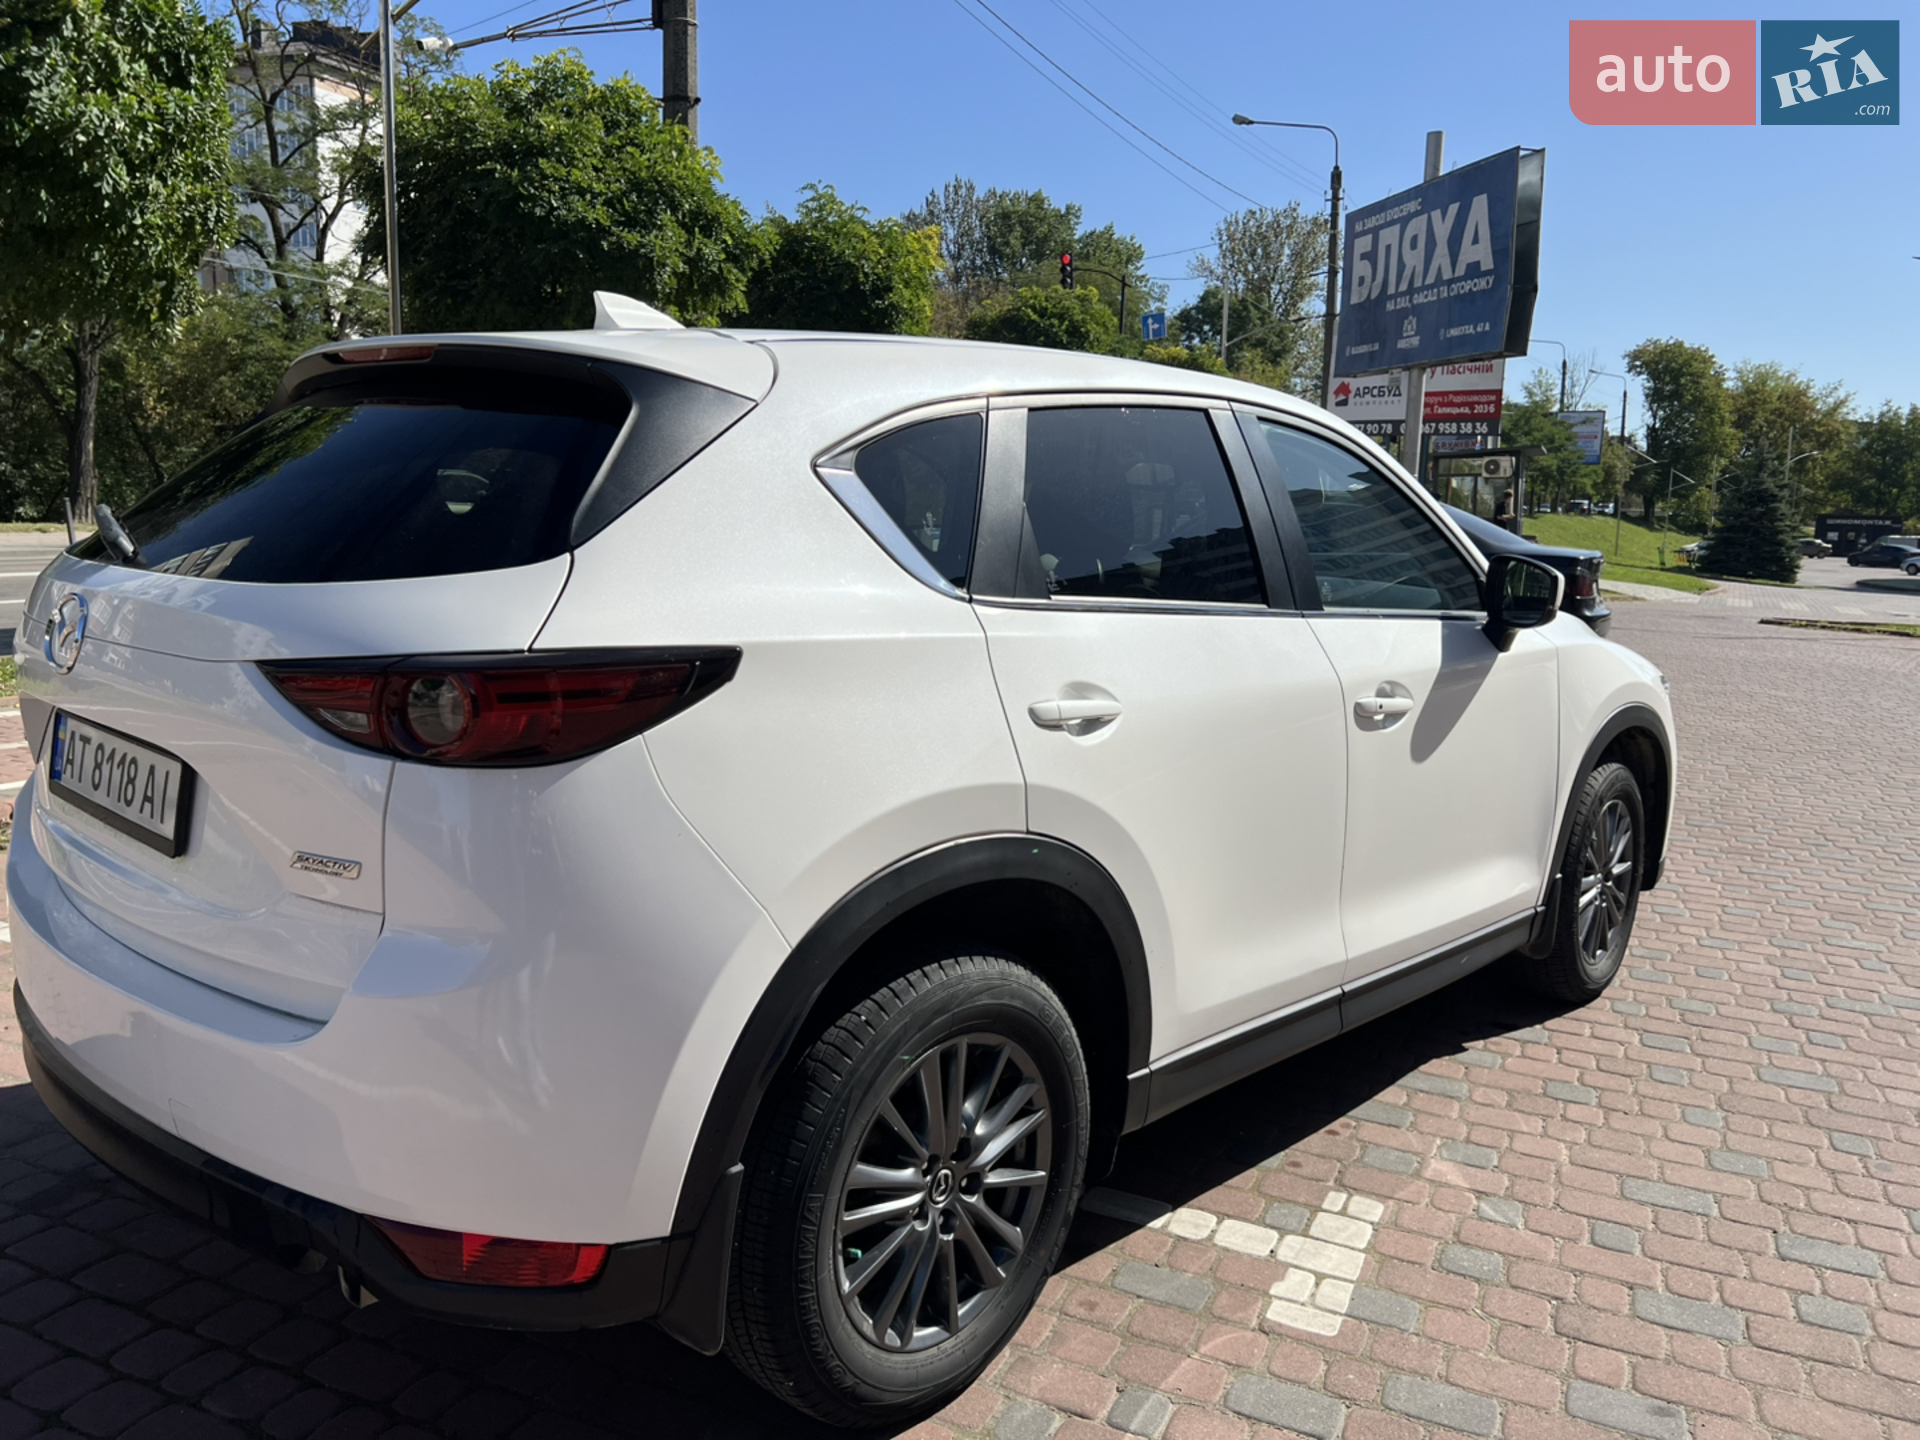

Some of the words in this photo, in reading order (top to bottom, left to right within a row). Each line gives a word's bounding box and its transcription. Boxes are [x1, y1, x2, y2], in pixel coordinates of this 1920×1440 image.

[1354, 220, 1363, 233] НА
[1350, 193, 1494, 305] БЛЯХА
[1385, 299, 1395, 312] НА
[1412, 288, 1437, 305] ФАСАД
[1439, 285, 1448, 299] ТА
[1449, 274, 1495, 296] ОГОРОЖУ
[1441, 360, 1494, 375] Пасічній
[1353, 385, 1402, 398] АРСБУД
[1366, 423, 1379, 434] 90
[1380, 423, 1393, 434] 78
[1437, 422, 1457, 434] 958
[1459, 422, 1472, 434] 38
[1474, 422, 1488, 434] 36
[63, 730, 91, 783] AT
[91, 742, 138, 807] 8118
[139, 763, 169, 824] AI
[296, 854, 352, 870] SKYACTIV
[797, 1193, 859, 1400] YOKOHAMA
